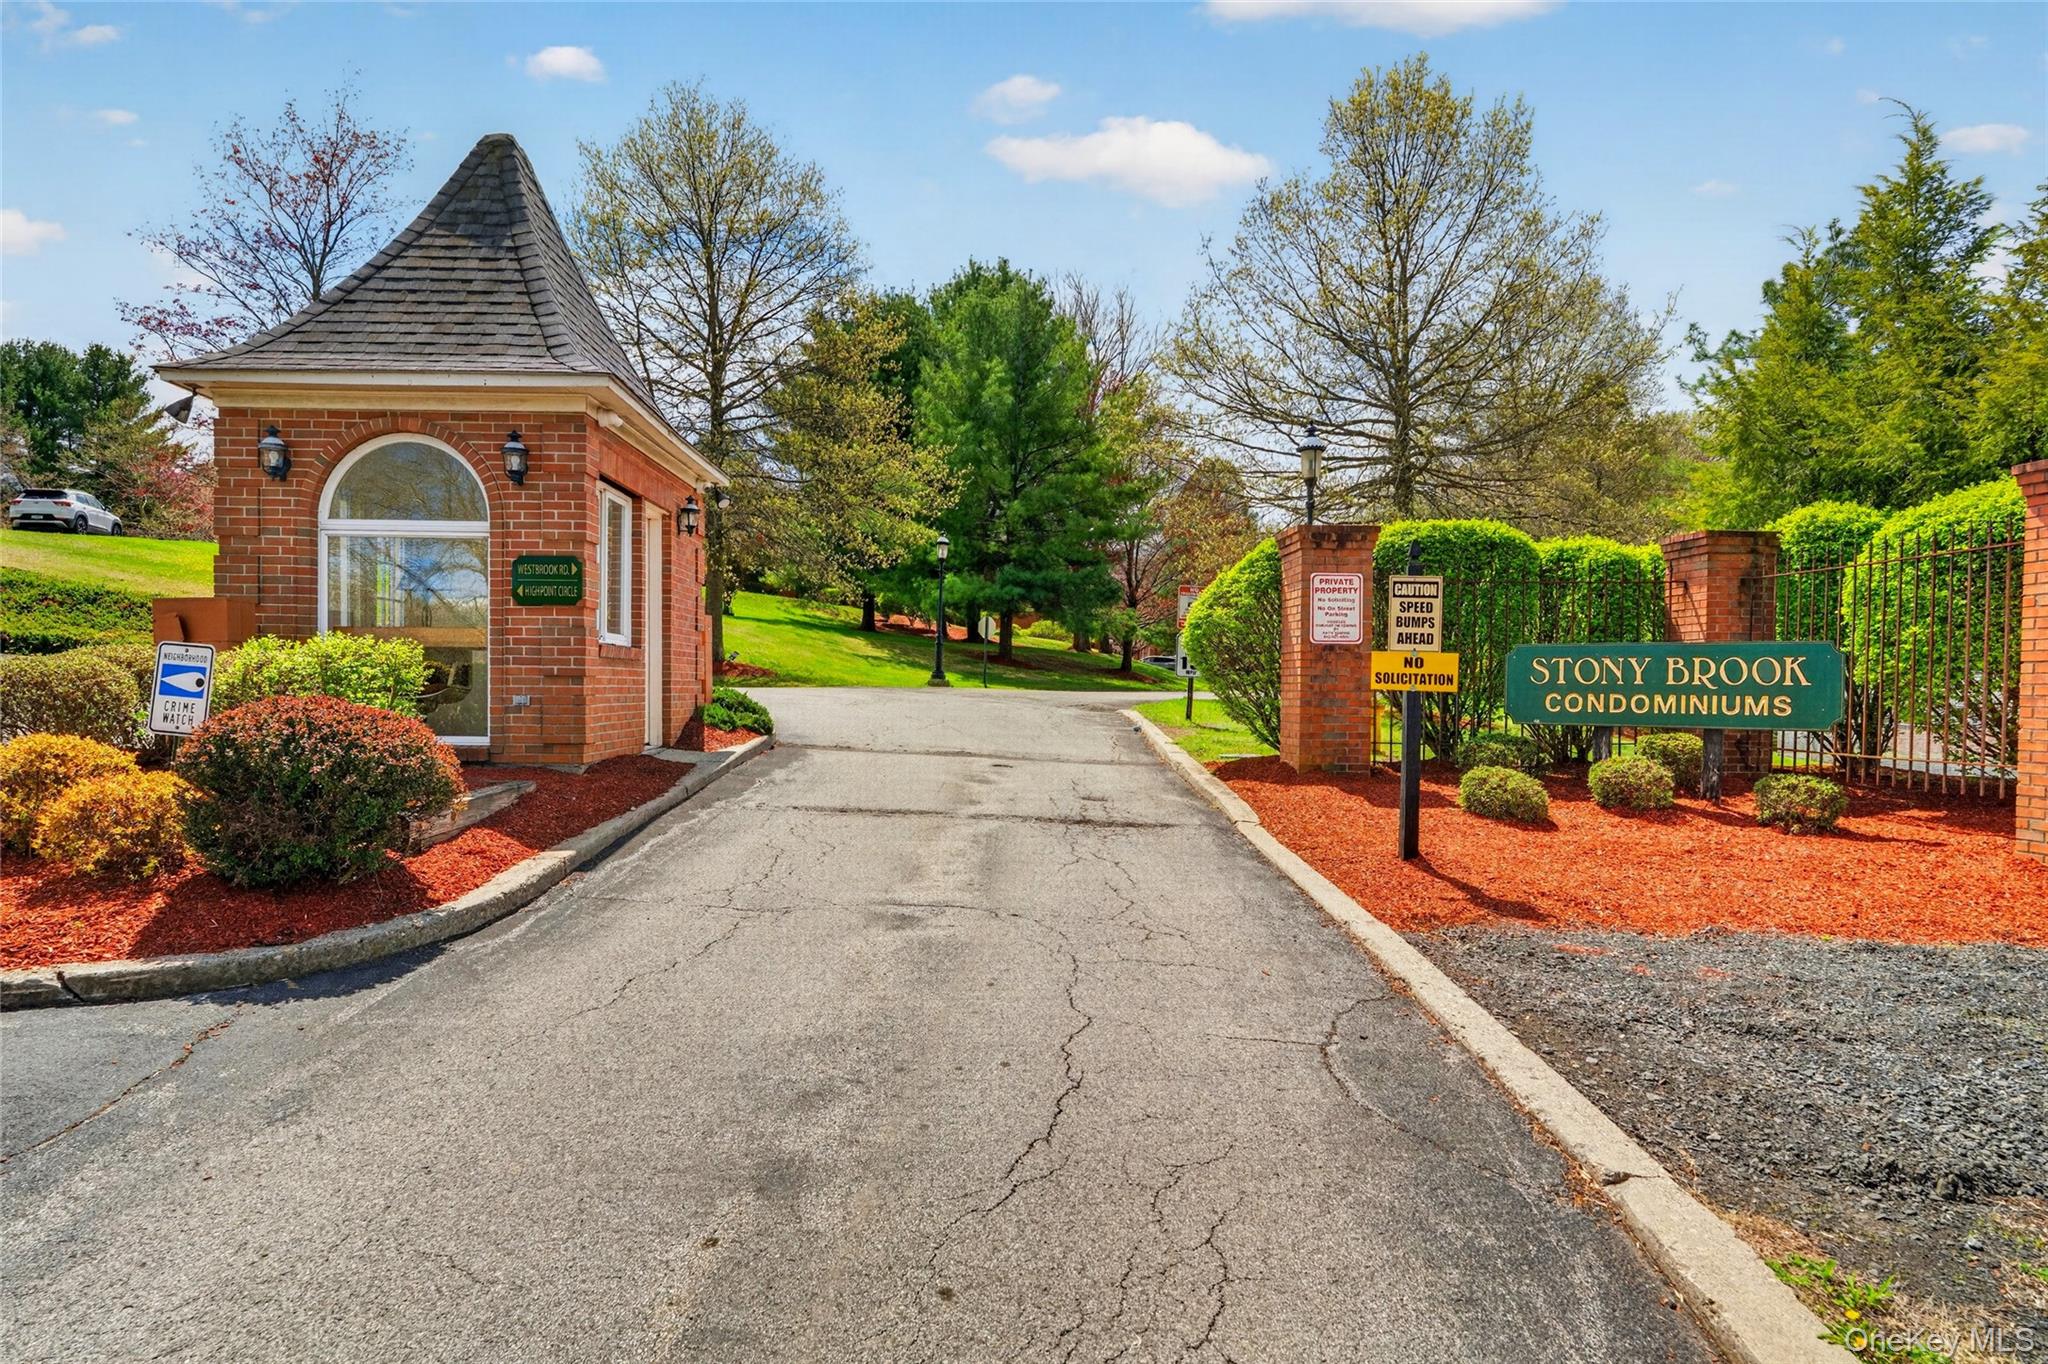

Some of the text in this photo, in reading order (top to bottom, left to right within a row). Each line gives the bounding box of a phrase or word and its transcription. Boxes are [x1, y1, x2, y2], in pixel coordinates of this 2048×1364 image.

[518, 564, 559, 575] WESTBROOK
[1319, 578, 1354, 586] PRIVATE
[524, 585, 578, 597] HIGHPOINT CIRCLE
[1314, 587, 1359, 595] PROPERTY
[1394, 583, 1438, 597] CAUTION
[1399, 601, 1434, 614] SPEED
[1396, 616, 1436, 629] BUMPS
[1397, 632, 1435, 645] AHEAD
[163, 652, 208, 664] NEIGHBORHOOD
[1404, 656, 1425, 669] NO
[1375, 671, 1455, 686] SOLICITATION
[1529, 656, 1813, 690] STONY BROOK
[164, 700, 196, 713] CRIME
[1544, 692, 1794, 718] CONDOMINIUMS
[162, 713, 194, 725] WATCH
